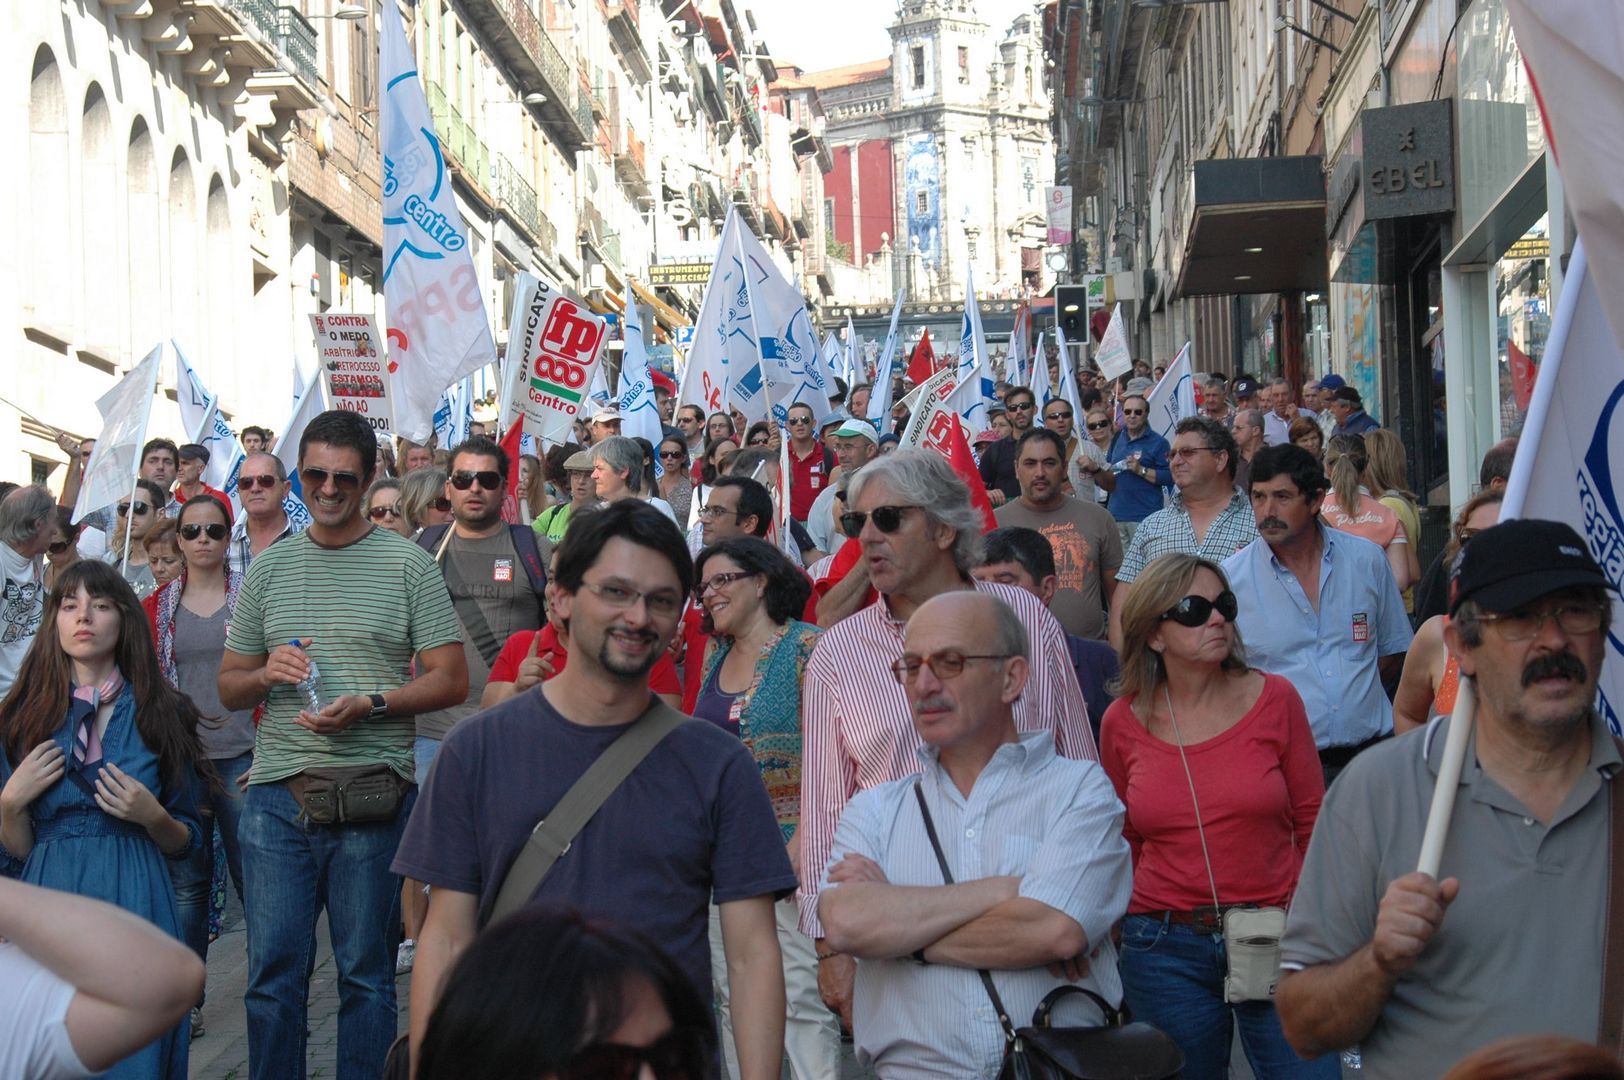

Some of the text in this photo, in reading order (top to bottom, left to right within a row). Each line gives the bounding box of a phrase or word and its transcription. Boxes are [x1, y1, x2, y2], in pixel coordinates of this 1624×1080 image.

[1370, 160, 1444, 194] EBEL
[404, 193, 465, 251] centro
[649, 264, 712, 274] INSTRUMENTO
[327, 316, 369, 327] CONTRA
[519, 280, 551, 383] SINDICATO
[329, 331, 370, 341] O MEDO
[336, 361, 381, 372] RETROCESSO
[356, 400, 369, 413] AO
[528, 387, 577, 416] Centro
[910, 392, 937, 446] SINDICATO
